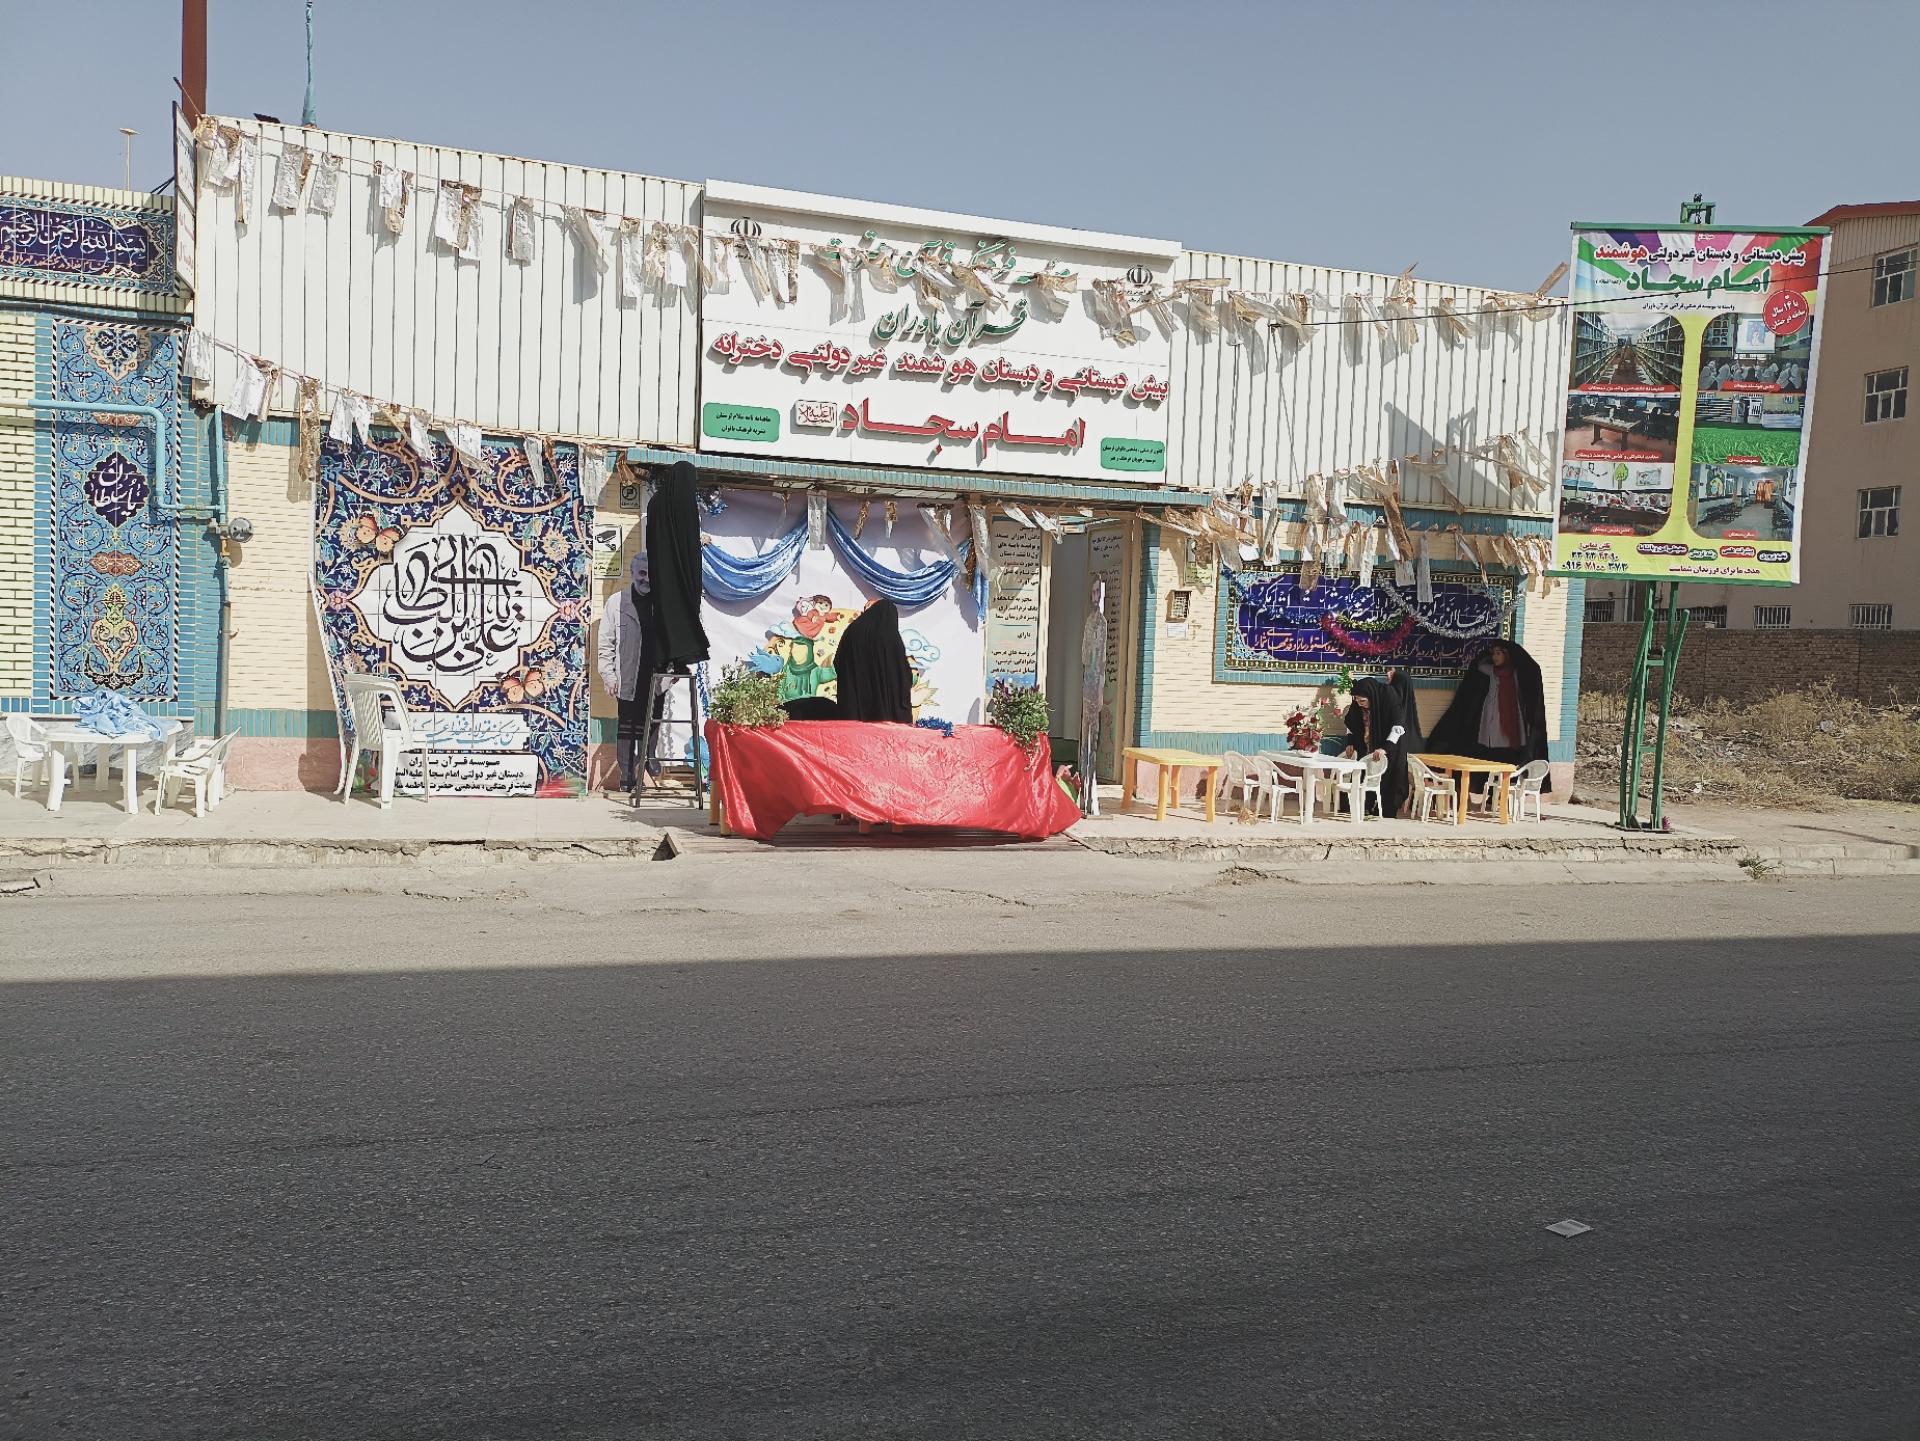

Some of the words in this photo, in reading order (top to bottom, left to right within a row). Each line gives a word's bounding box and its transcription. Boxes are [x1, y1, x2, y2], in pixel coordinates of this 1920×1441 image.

[1595, 243, 1648, 262] هوشمند
[1698, 246, 1732, 262] دبستان
[1742, 246, 1782, 263] دبستانی
[1782, 251, 1806, 266] پیش
[1627, 266, 1704, 298] سجاد
[1706, 267, 1771, 298] امام
[712, 330, 784, 364] دخترانه
[786, 340, 851, 375] دولتی
[851, 347, 887, 375] غیر
[981, 357, 1041, 387] دبستان
[1042, 369, 1054, 393] و
[1056, 366, 1128, 398] دبستانی
[1131, 375, 1169, 401] پیش
[840, 397, 980, 455] سجاد
[980, 410, 1087, 460] امام
[440, 755, 468, 768] قرآن
